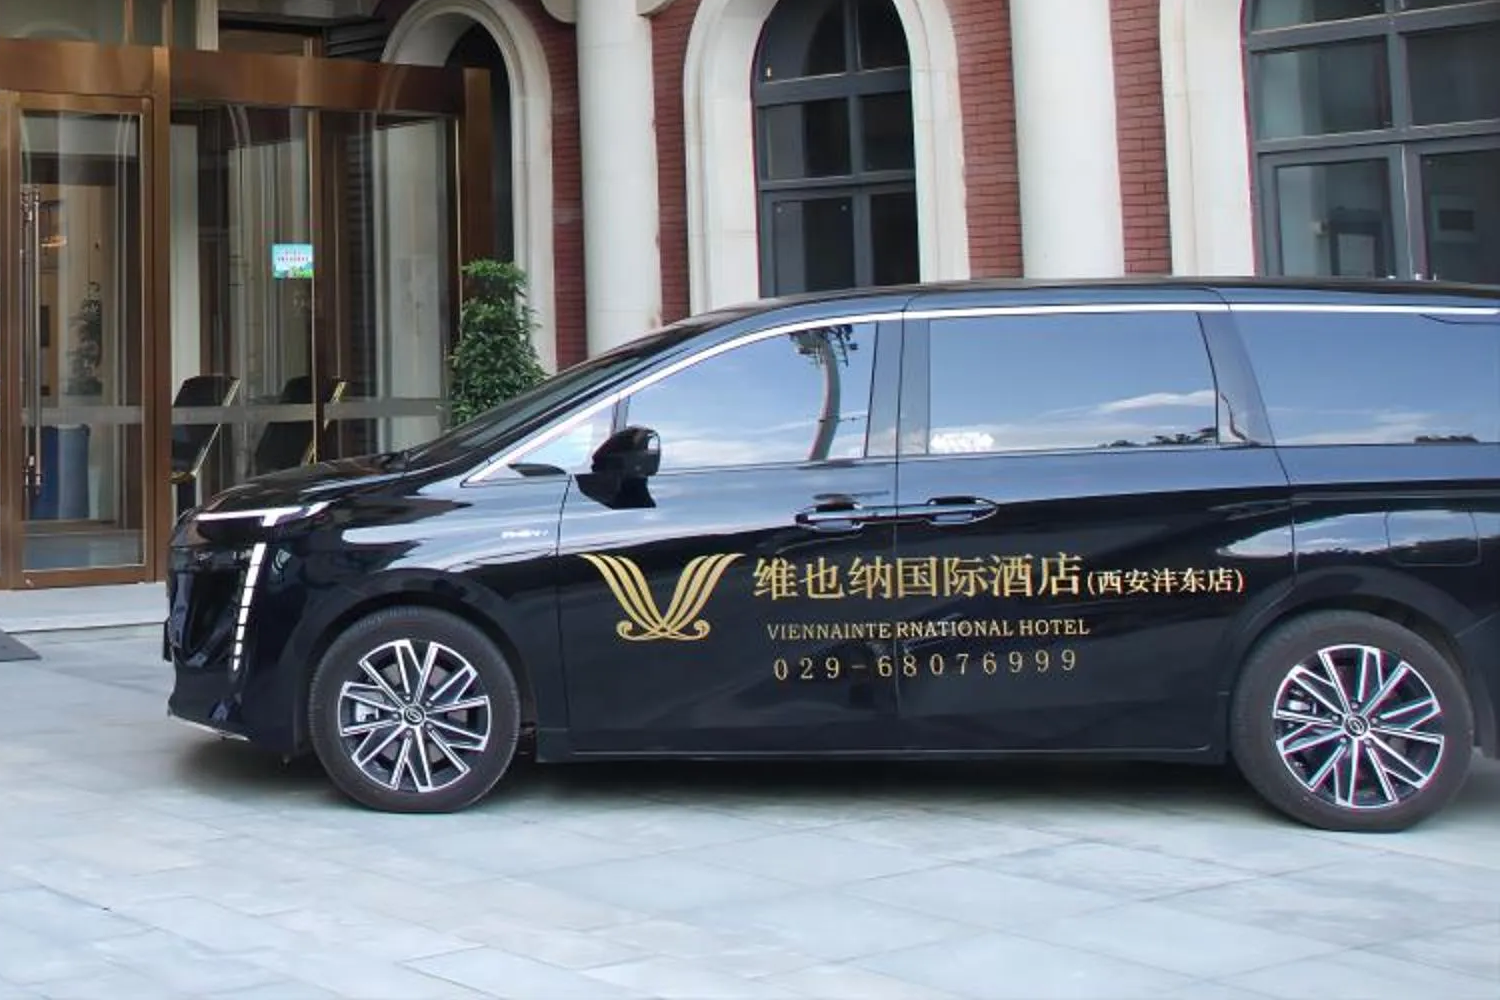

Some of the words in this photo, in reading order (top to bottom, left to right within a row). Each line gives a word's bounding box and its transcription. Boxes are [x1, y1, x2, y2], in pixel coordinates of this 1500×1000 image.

[752, 551, 1083, 601] 维也纳国际酒店
[1019, 619, 1092, 637] HOTEL
